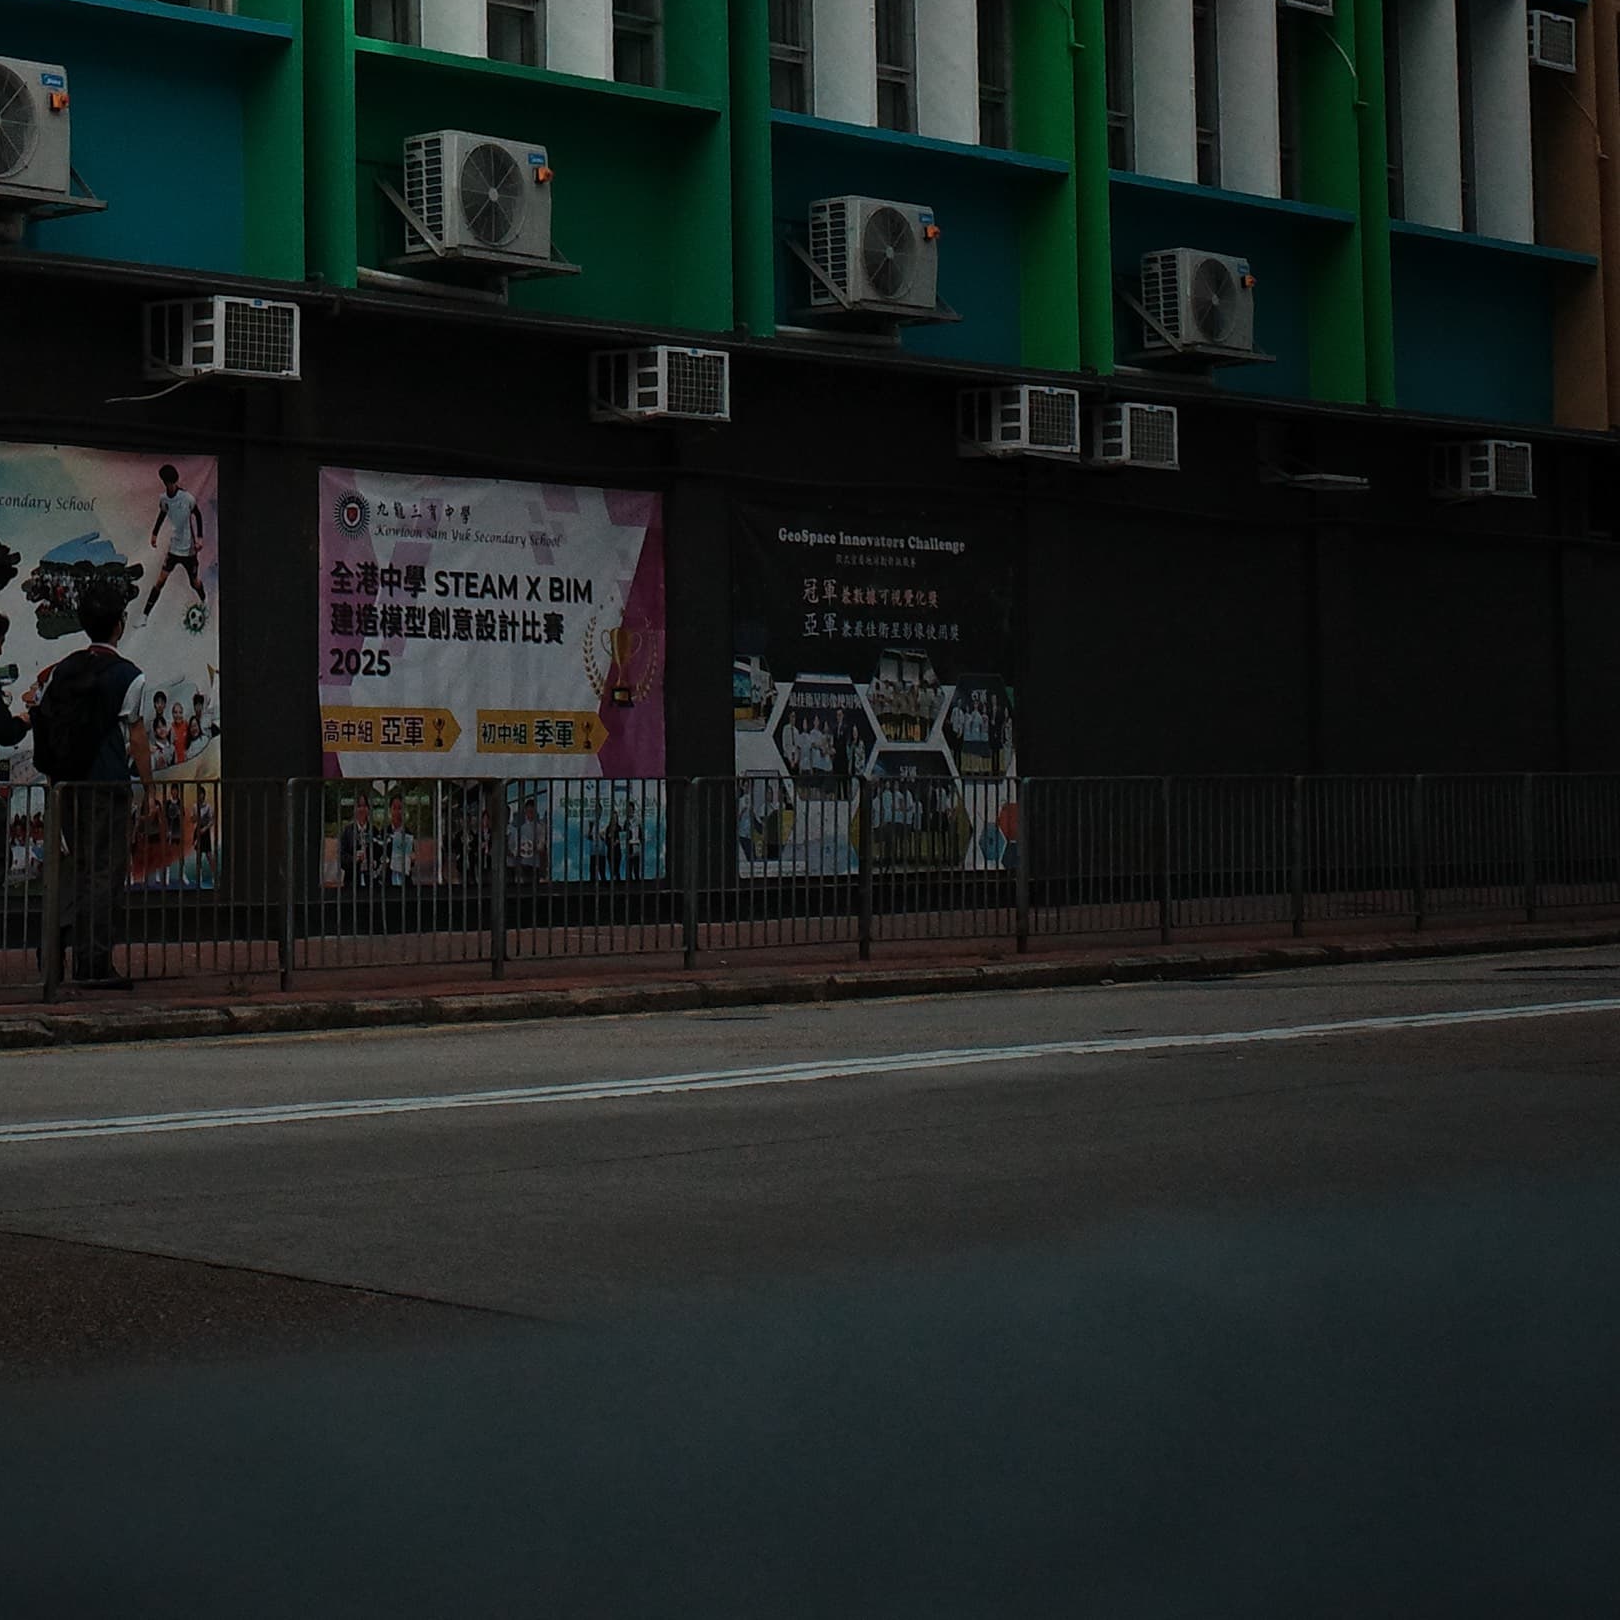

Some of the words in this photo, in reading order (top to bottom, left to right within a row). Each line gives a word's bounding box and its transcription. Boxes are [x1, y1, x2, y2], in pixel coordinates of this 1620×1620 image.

[56, 497, 97, 512] School
[377, 502, 471, 524] 九龍三育中學
[374, 524, 422, 538] Kowloon
[426, 528, 448, 541] Sam
[451, 528, 470, 542] Yuk
[474, 531, 527, 548] Secondary
[529, 533, 563, 548] School
[778, 527, 836, 547] GeoSpace
[839, 531, 905, 548] Innovators
[907, 536, 965, 555] Challenge
[330, 561, 427, 598] 全港中學
[435, 571, 518, 600] STEAM
[526, 575, 541, 602] X
[549, 577, 593, 604] BIM
[803, 577, 837, 605] 冠軍
[330, 602, 564, 644] 建造模型創意設計比賽
[803, 612, 838, 639] 亞軍
[330, 649, 391, 676] 2025
[324, 720, 373, 743] 高中組
[381, 717, 424, 747] 亞軍
[482, 722, 527, 745] 初中組
[534, 720, 574, 748] 季軍
